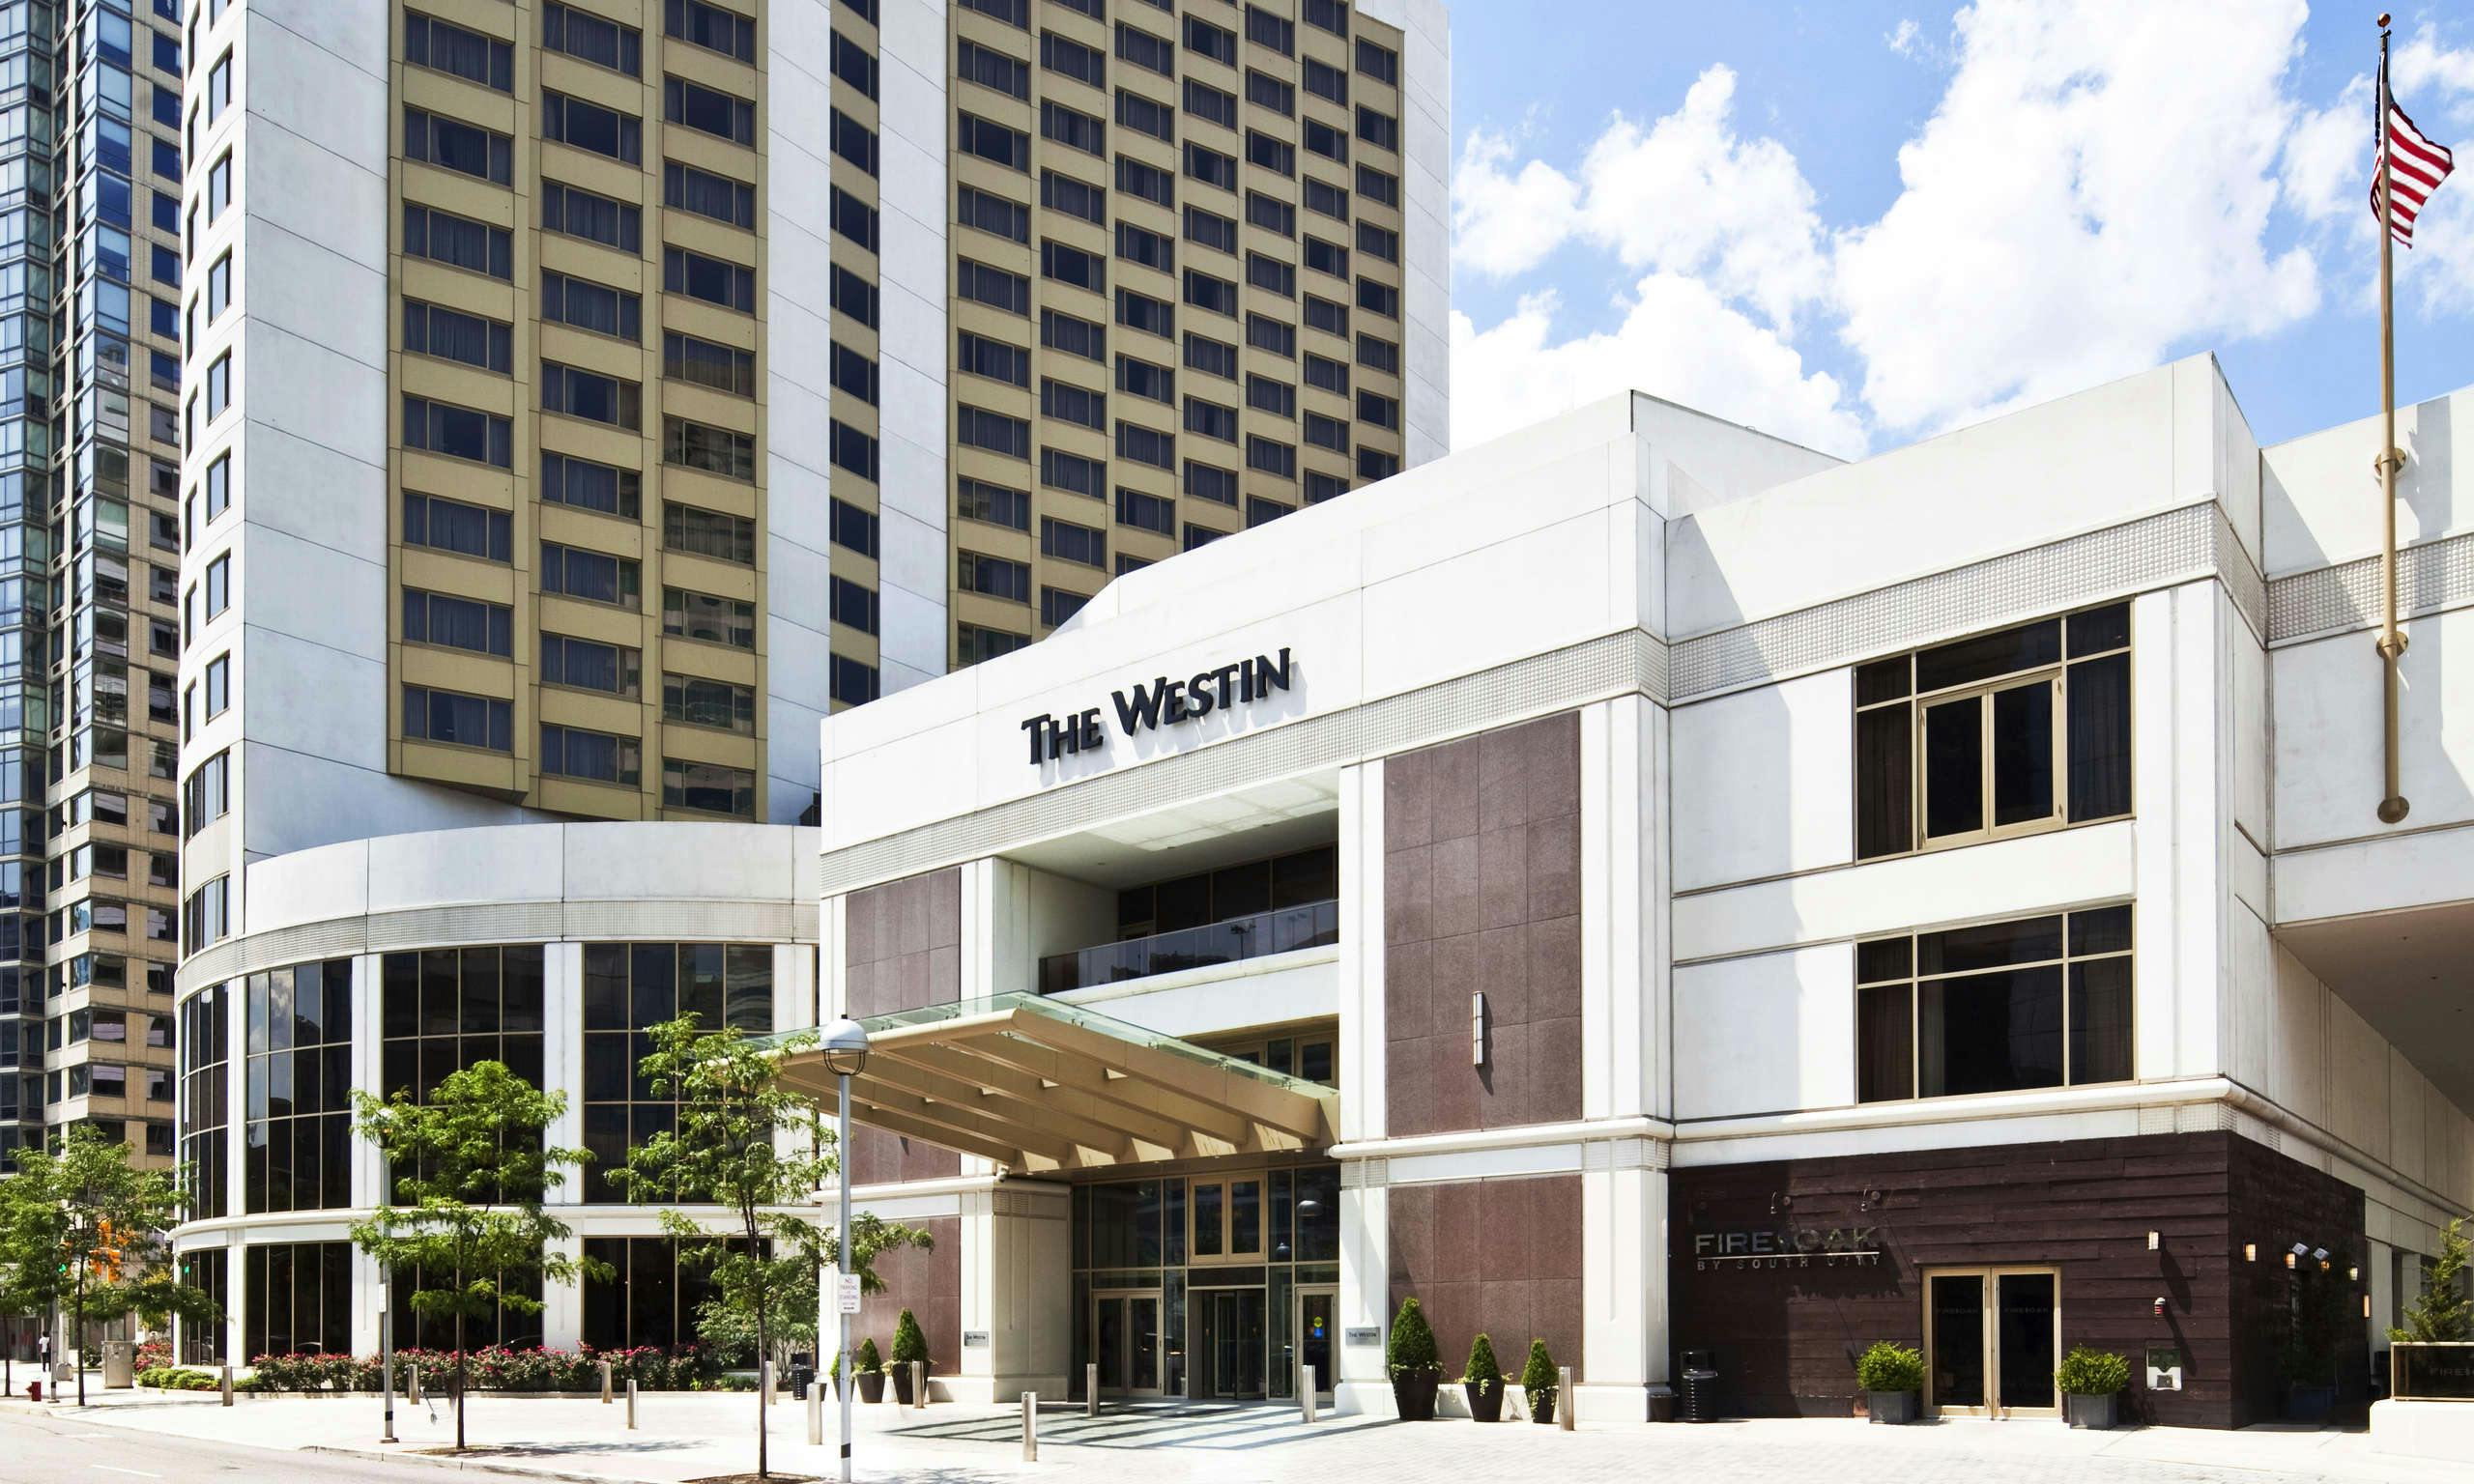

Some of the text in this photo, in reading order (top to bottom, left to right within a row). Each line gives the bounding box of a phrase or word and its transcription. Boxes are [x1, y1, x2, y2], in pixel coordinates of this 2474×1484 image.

[1021, 647, 1291, 764] THE WESTIN
[1695, 1232, 1774, 1254] FIRE
[1697, 1260, 1720, 1270] BY
